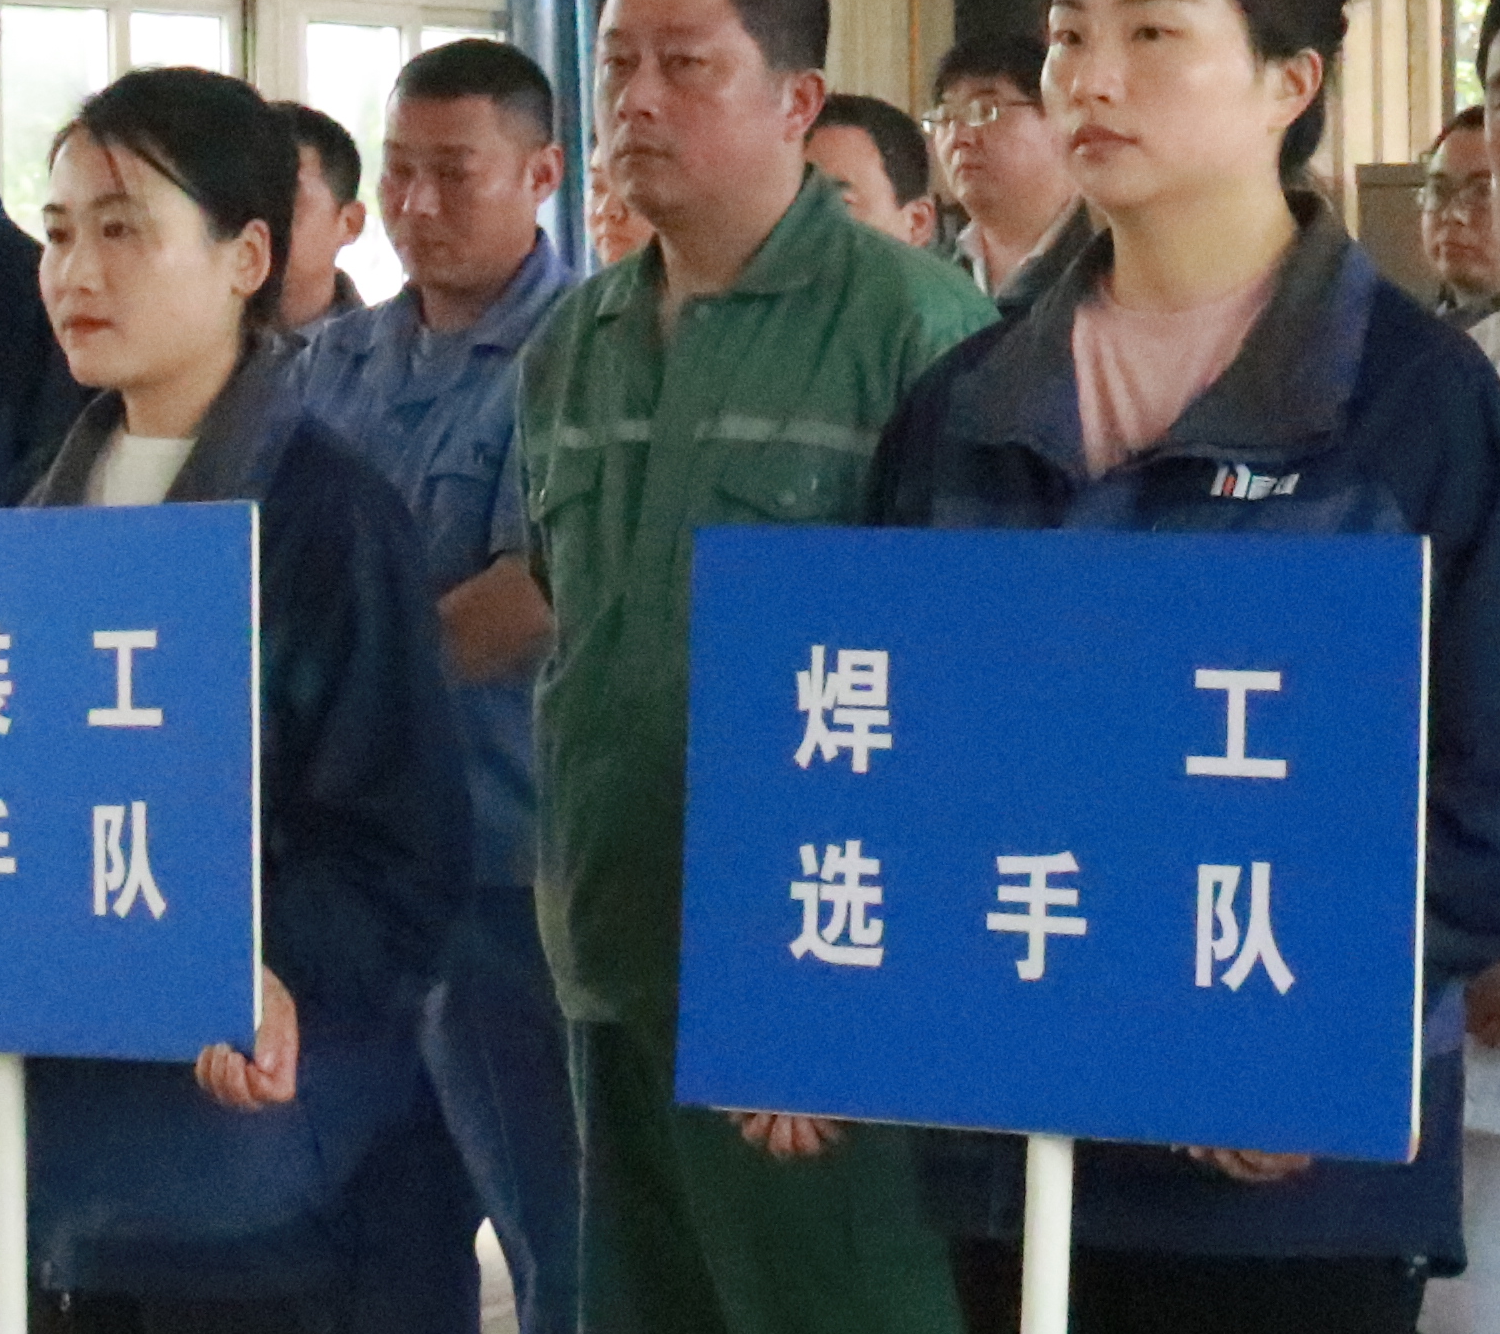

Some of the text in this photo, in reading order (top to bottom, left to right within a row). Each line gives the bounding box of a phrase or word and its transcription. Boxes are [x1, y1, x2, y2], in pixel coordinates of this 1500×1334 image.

[796, 646, 1286, 777] 焊工
[791, 841, 1293, 992] 选手队
